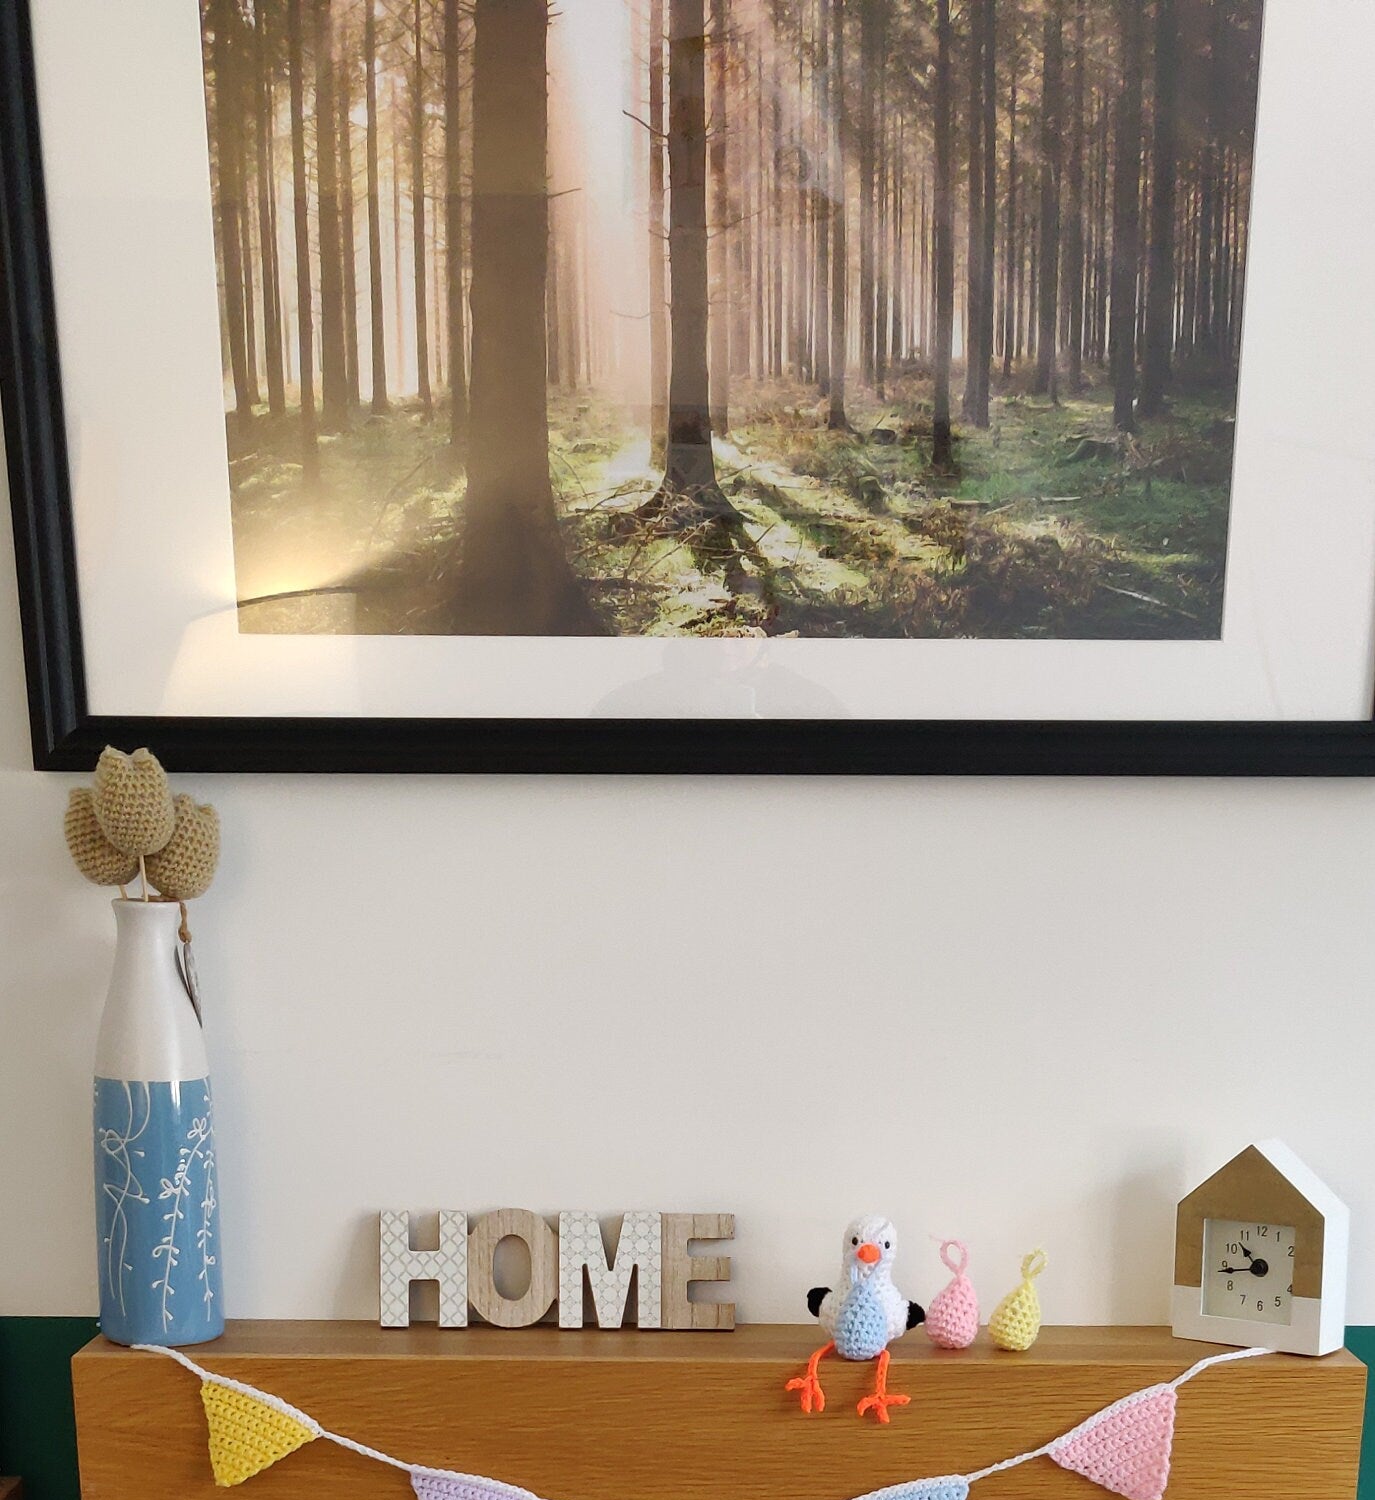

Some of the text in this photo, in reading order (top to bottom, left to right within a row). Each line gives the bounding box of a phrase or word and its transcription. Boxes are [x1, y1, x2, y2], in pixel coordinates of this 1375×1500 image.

[1240, 1230, 1249, 1241] 11
[1257, 1226, 1268, 1237] 12
[1276, 1231, 1280, 1242] 1
[1226, 1243, 1238, 1254] 10
[1287, 1245, 1295, 1257] 2
[379, 1208, 735, 1330] HOME
[1227, 1280, 1233, 1291] 8
[1240, 1295, 1246, 1305] 7
[1274, 1296, 1281, 1308] 5
[1257, 1301, 1263, 1312] 6
